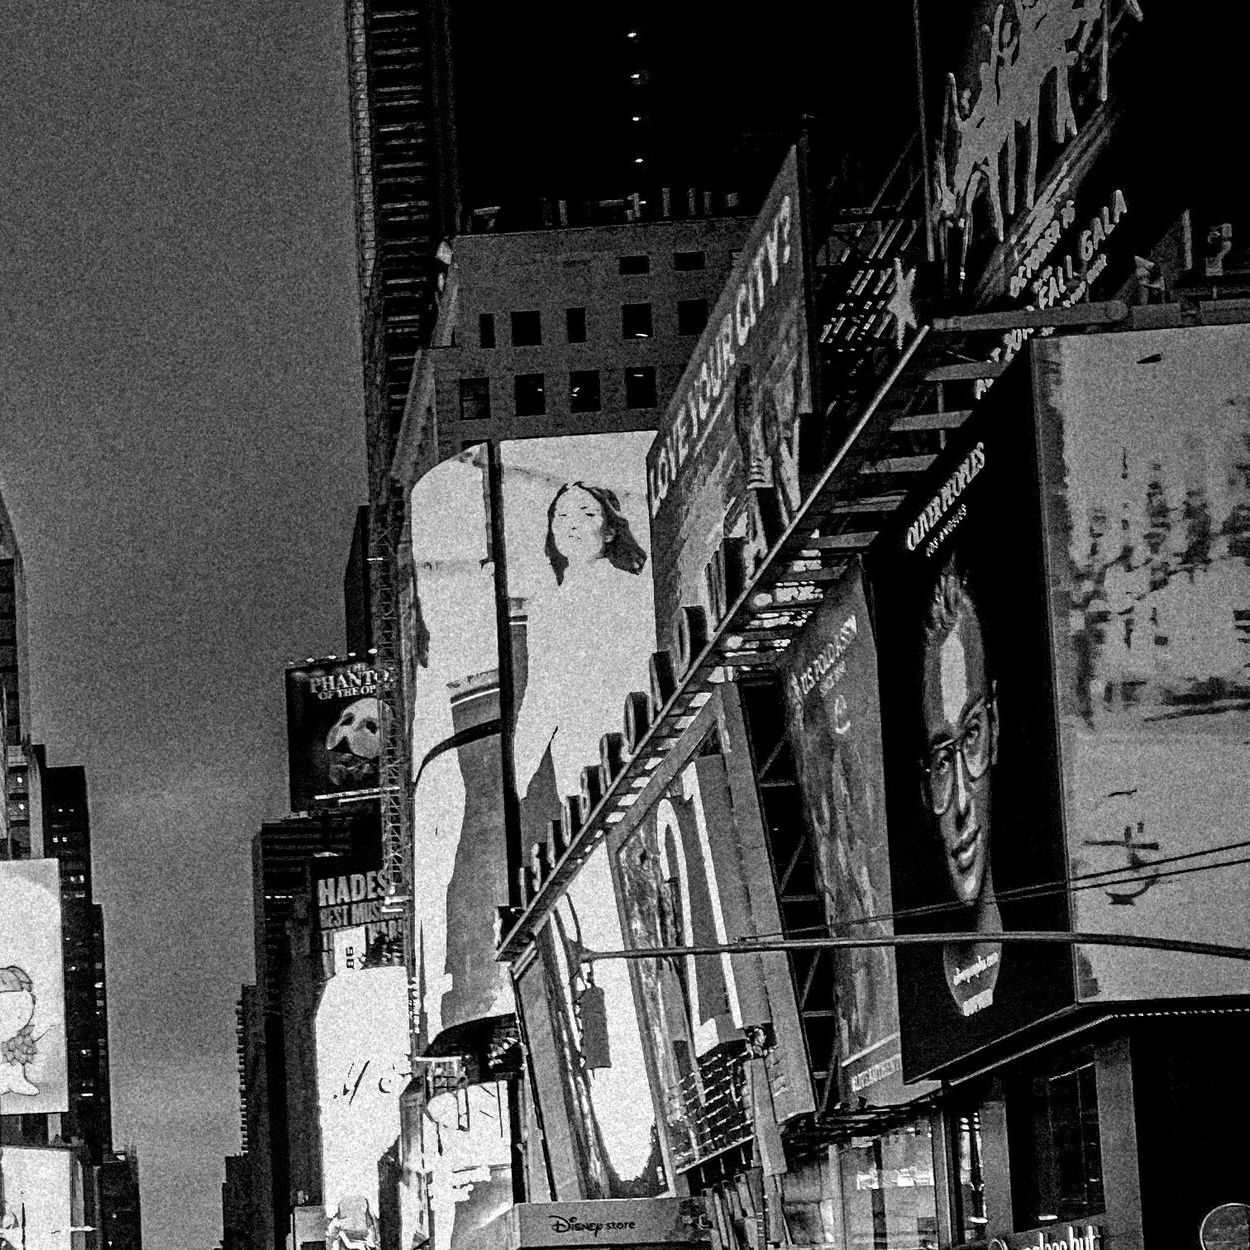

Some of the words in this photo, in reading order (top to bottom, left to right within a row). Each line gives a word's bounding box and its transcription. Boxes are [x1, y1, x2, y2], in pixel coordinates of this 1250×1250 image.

[1081, 189, 1128, 262] GALA
[309, 669, 391, 693] PHANTO
[317, 869, 391, 907] HADES
[548, 1215, 604, 1239] Disney
[606, 1221, 636, 1231] store
